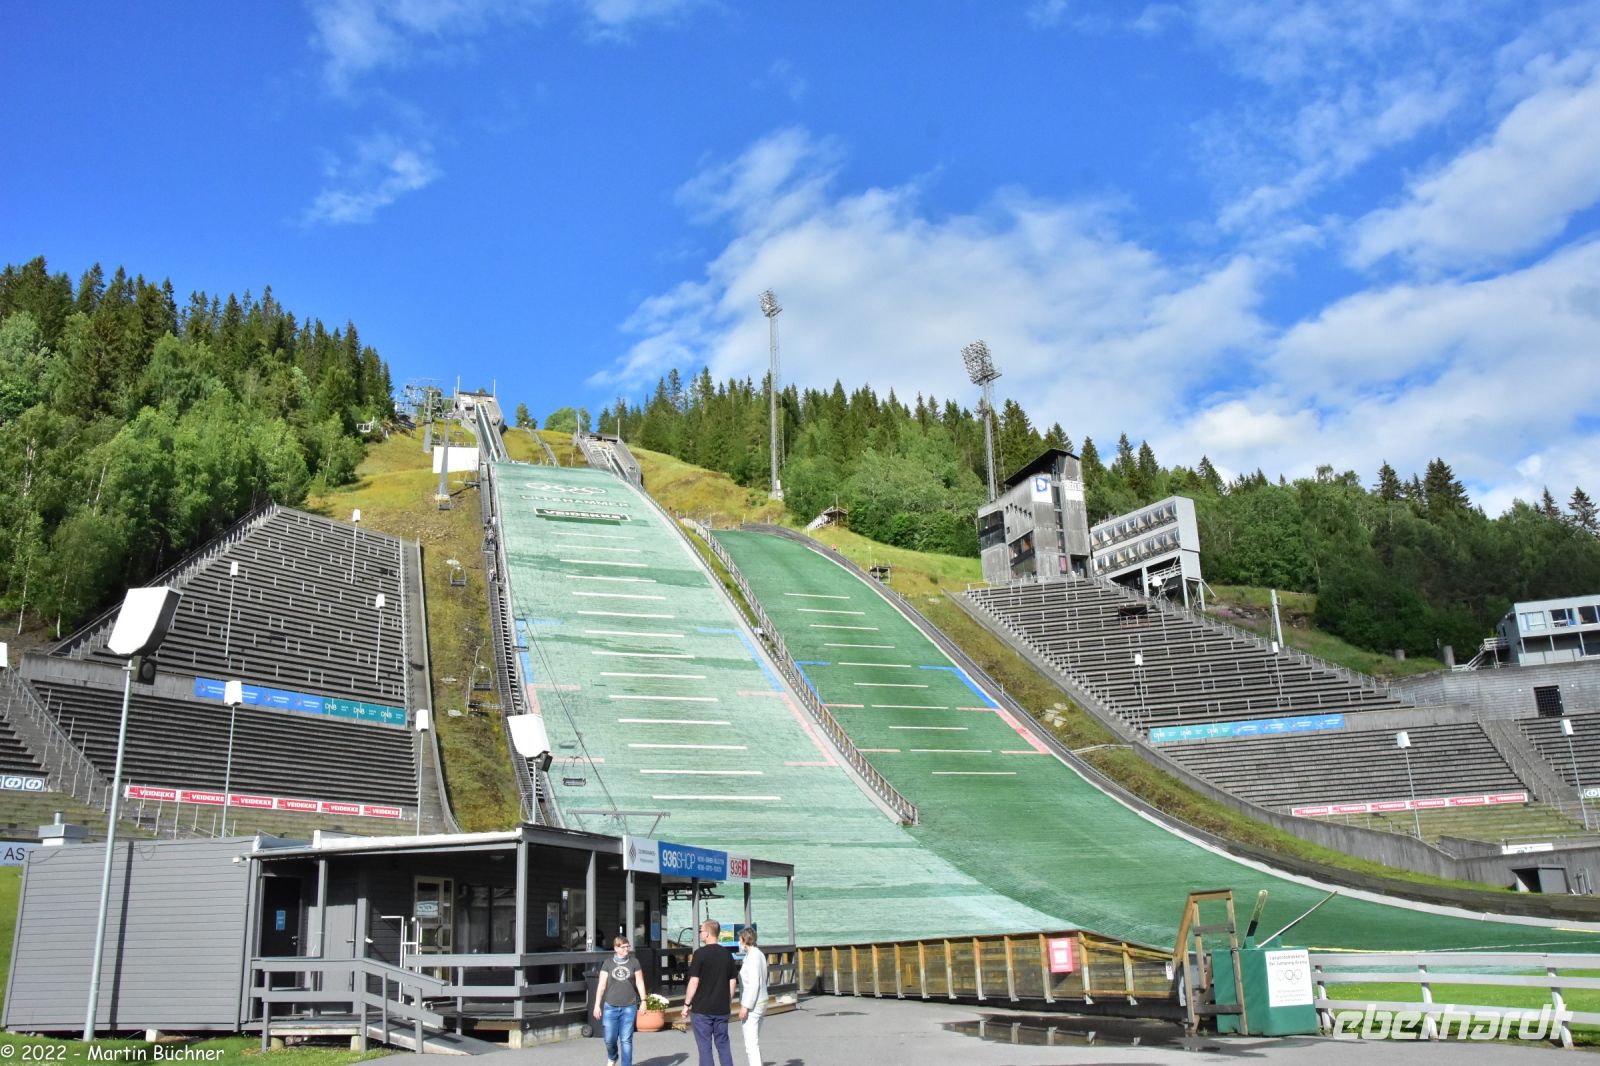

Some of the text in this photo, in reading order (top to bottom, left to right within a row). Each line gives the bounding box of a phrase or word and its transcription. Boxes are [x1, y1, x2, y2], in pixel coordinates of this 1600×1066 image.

[520, 495, 631, 508] LILLEHAMMER
[543, 509, 621, 519] VEIDEKKE
[324, 701, 337, 712] DNB
[353, 705, 365, 716] DNB
[380, 709, 393, 719] DNB
[139, 789, 175, 799] VEIDEKKE
[191, 793, 225, 802] VEIDEKKE
[240, 797, 272, 806] VEIDEKKE
[286, 800, 317, 809] VEIDEKKE
[330, 805, 359, 813] VEIDEKKE
[372, 808, 399, 816] VEIDEKKE
[4, 847, 25, 861] AS
[730, 859, 742, 875] 936
